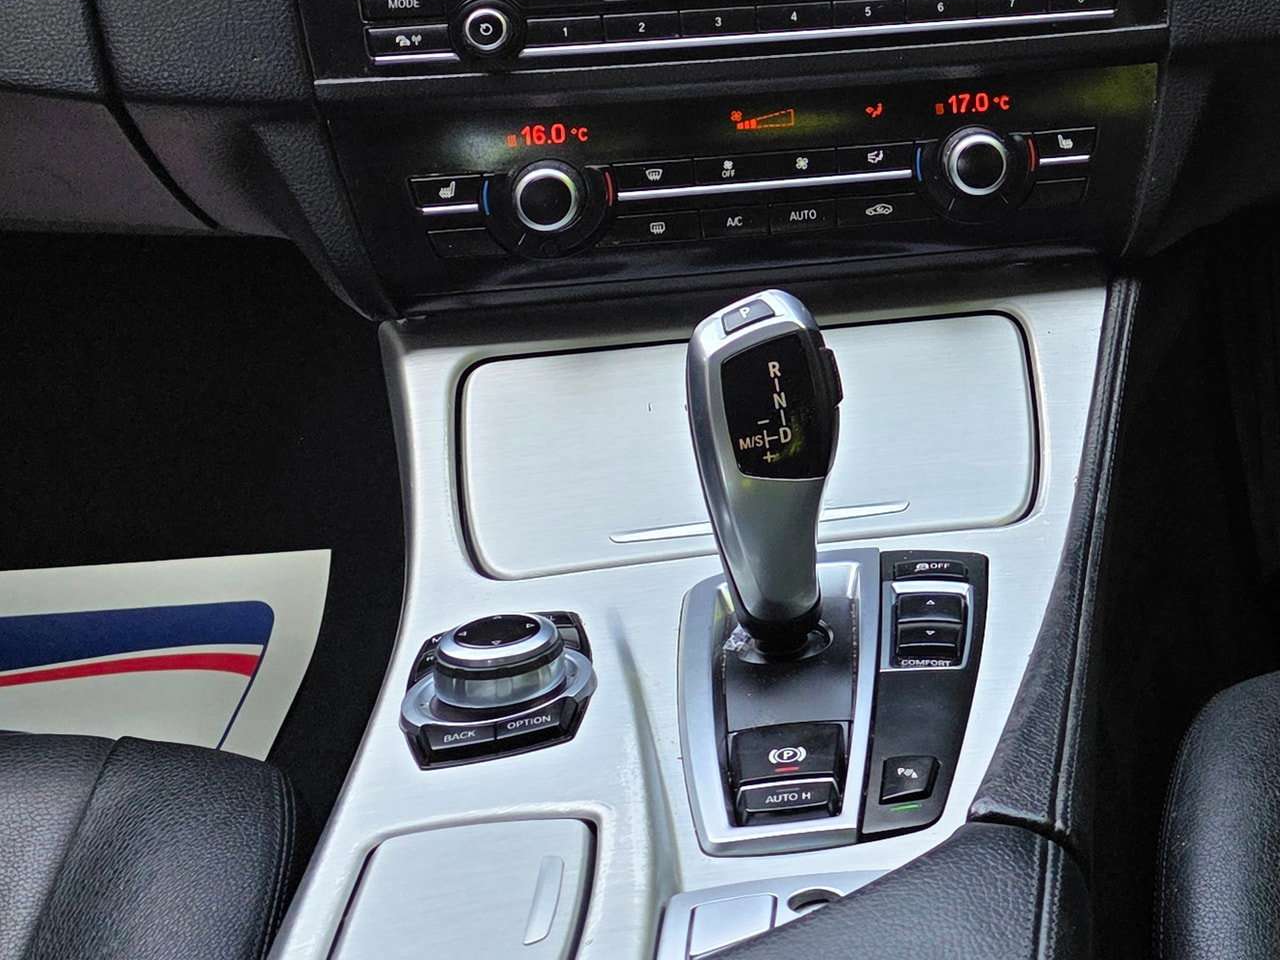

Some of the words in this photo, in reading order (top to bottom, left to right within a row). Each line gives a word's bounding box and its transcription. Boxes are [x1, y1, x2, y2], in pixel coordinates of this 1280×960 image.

[864, 6, 872, 17] 5
[937, 2, 945, 13] 6
[714, 16, 723, 27] 3
[789, 11, 798, 22] 4
[562, 27, 568, 37] 1
[638, 22, 646, 33] 2
[948, 92, 989, 114] 17.0
[521, 123, 566, 146] 16.0
[721, 169, 736, 178] OFF
[726, 216, 743, 228] A/C
[789, 209, 817, 222] AUTO
[739, 306, 750, 319] P
[767, 361, 782, 378] R
[773, 392, 787, 410] N
[739, 434, 764, 451] M/S
[778, 426, 792, 444] D
[901, 659, 951, 667] COMFORT
[506, 714, 551, 730] OPTION
[443, 729, 476, 743] BACK
[765, 792, 798, 804] AUTO
[802, 791, 811, 801] H
